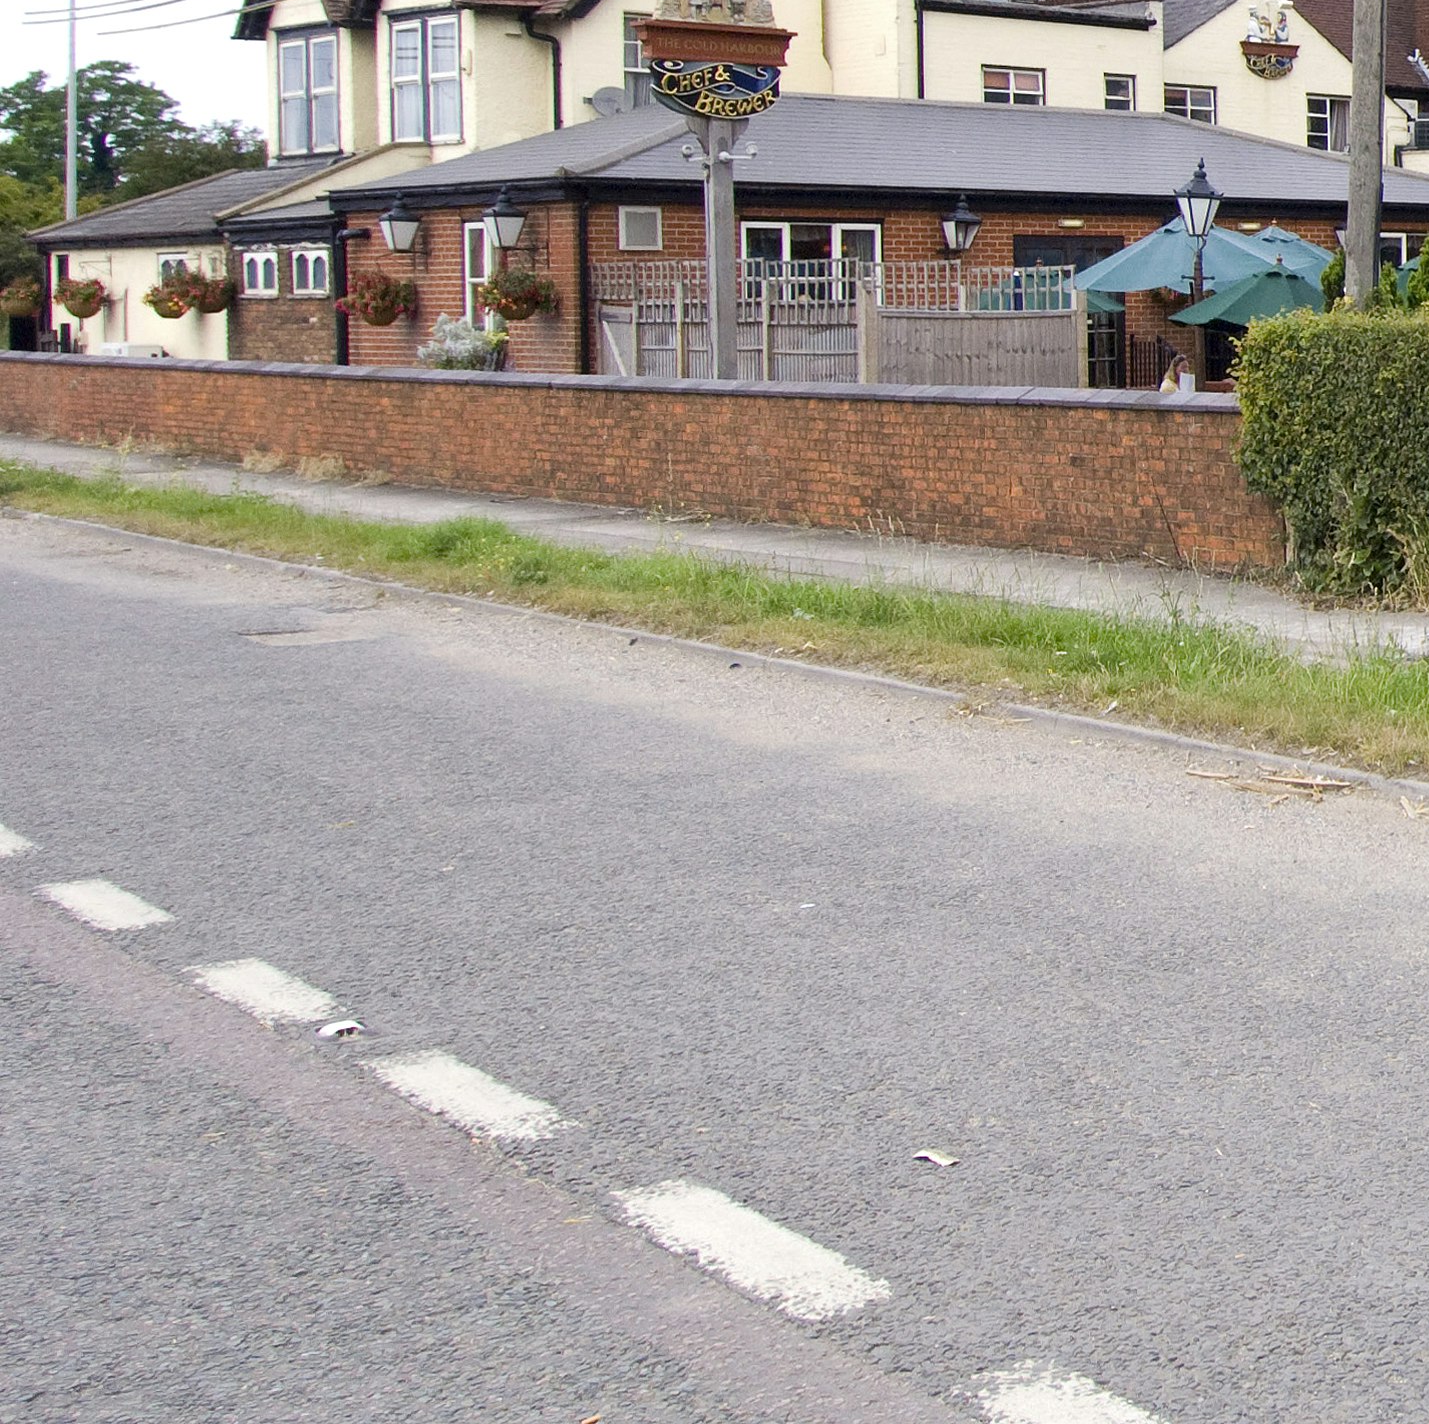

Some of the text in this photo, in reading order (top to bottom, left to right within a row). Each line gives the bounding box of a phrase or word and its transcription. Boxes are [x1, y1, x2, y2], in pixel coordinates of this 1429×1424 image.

[656, 36, 781, 55] THE COLD HARBOUR
[714, 64, 731, 81] &
[695, 89, 777, 116] BREWER
